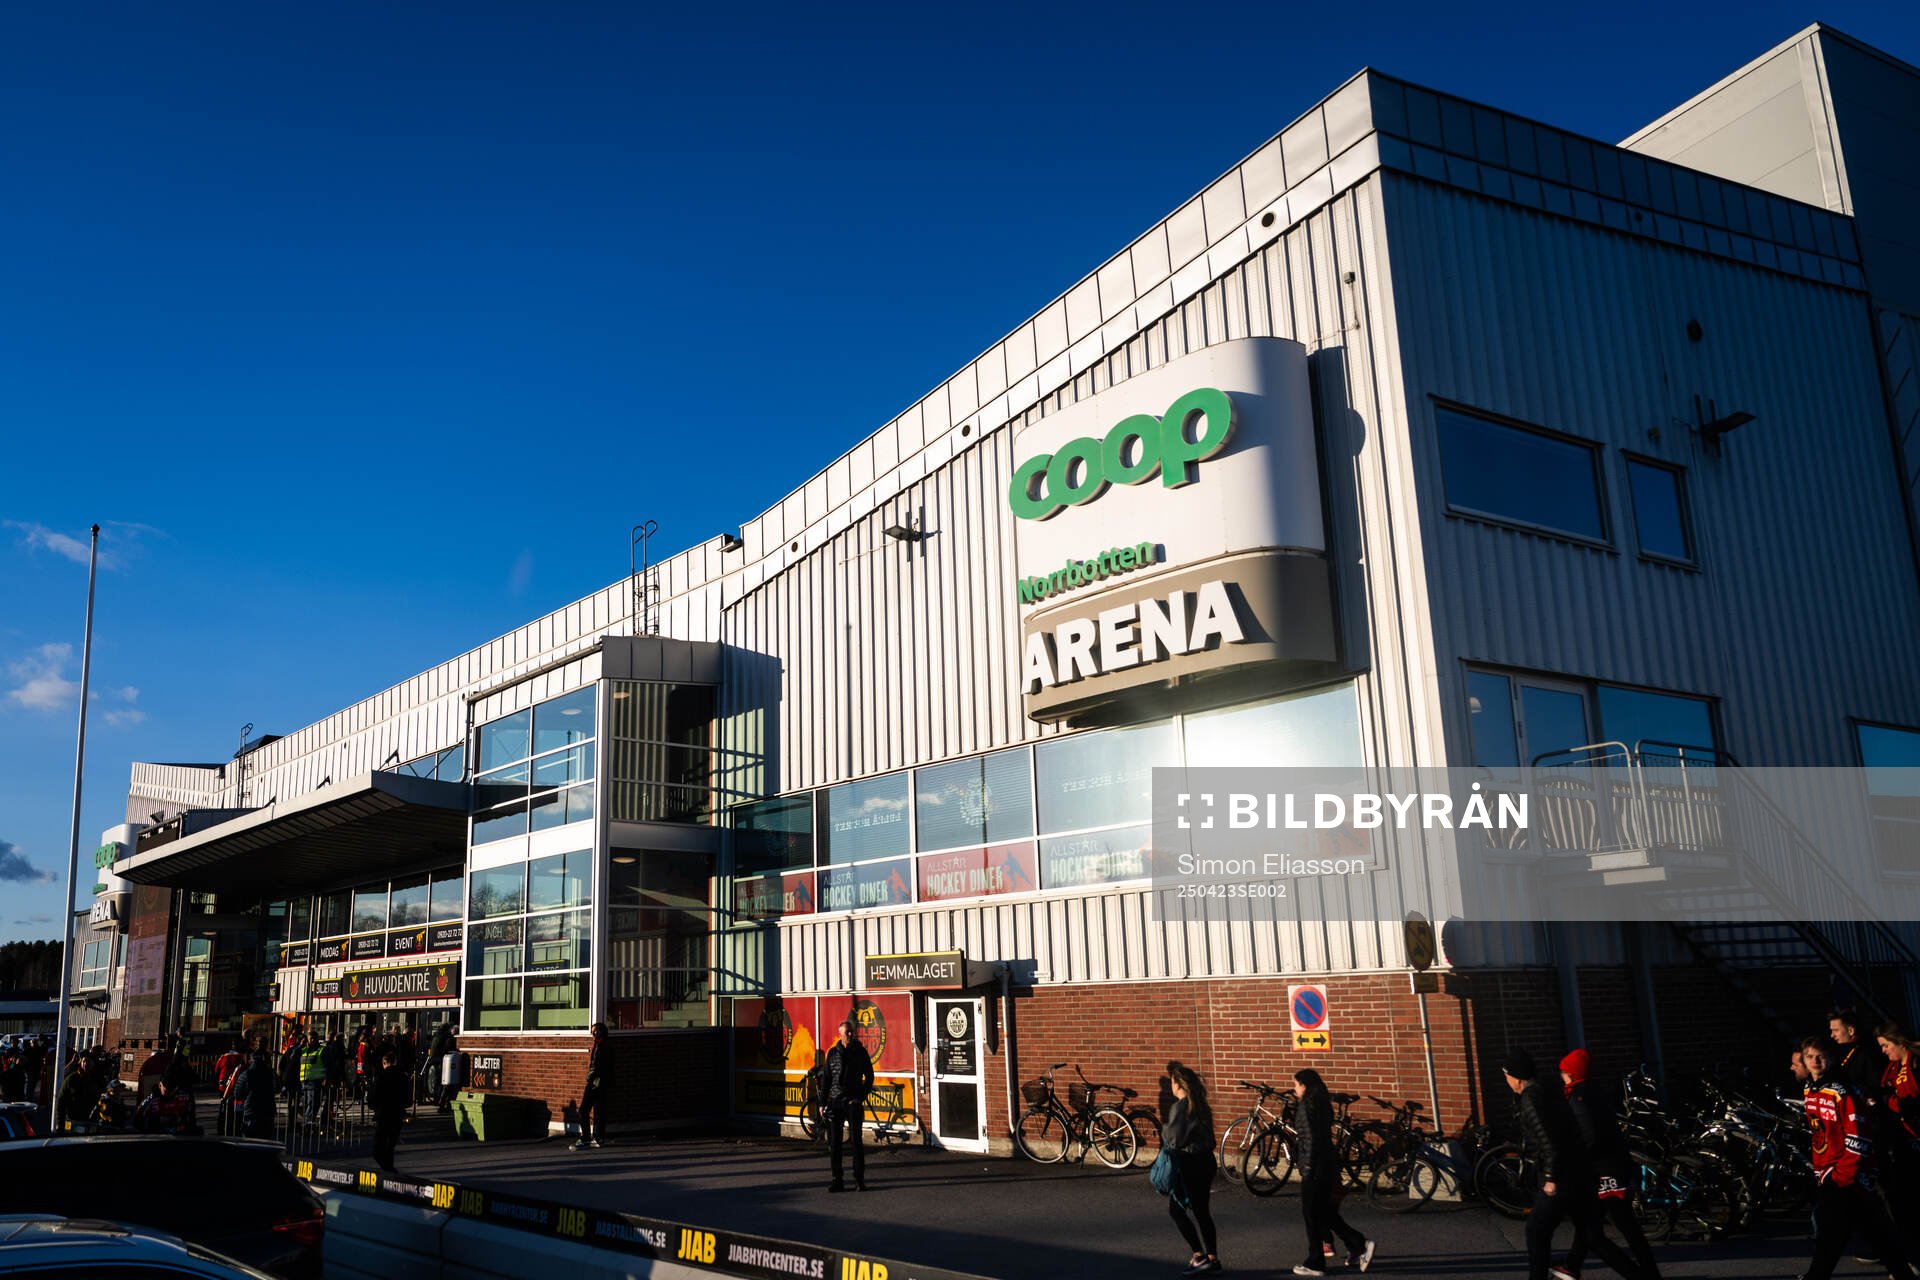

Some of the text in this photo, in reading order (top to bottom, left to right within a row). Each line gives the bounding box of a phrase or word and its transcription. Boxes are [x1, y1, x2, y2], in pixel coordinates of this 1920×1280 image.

[1009, 387, 1233, 521] coop
[1018, 541, 1154, 604] Norrbotten
[1021, 580, 1245, 694] ARENA
[1050, 839, 1098, 857] ALLSTAR
[927, 855, 967, 873] ALLSTAR
[926, 865, 1003, 897] HOCKEY DINER
[823, 880, 888, 908] HOCKEY DINER
[395, 937, 414, 950] EVENT
[364, 968, 430, 995] HUVUDENTRÉ
[870, 962, 956, 981] HEMMALAGET
[316, 982, 339, 994] BILJETTER
[474, 1057, 500, 1069] BILJETTER
[297, 1160, 313, 1181] JIAB
[458, 1189, 485, 1216] JIAB
[556, 1207, 587, 1238] JIAB
[678, 1228, 716, 1264] JIAB
[728, 1243, 824, 1279] JIABHYRCENTER.SE
